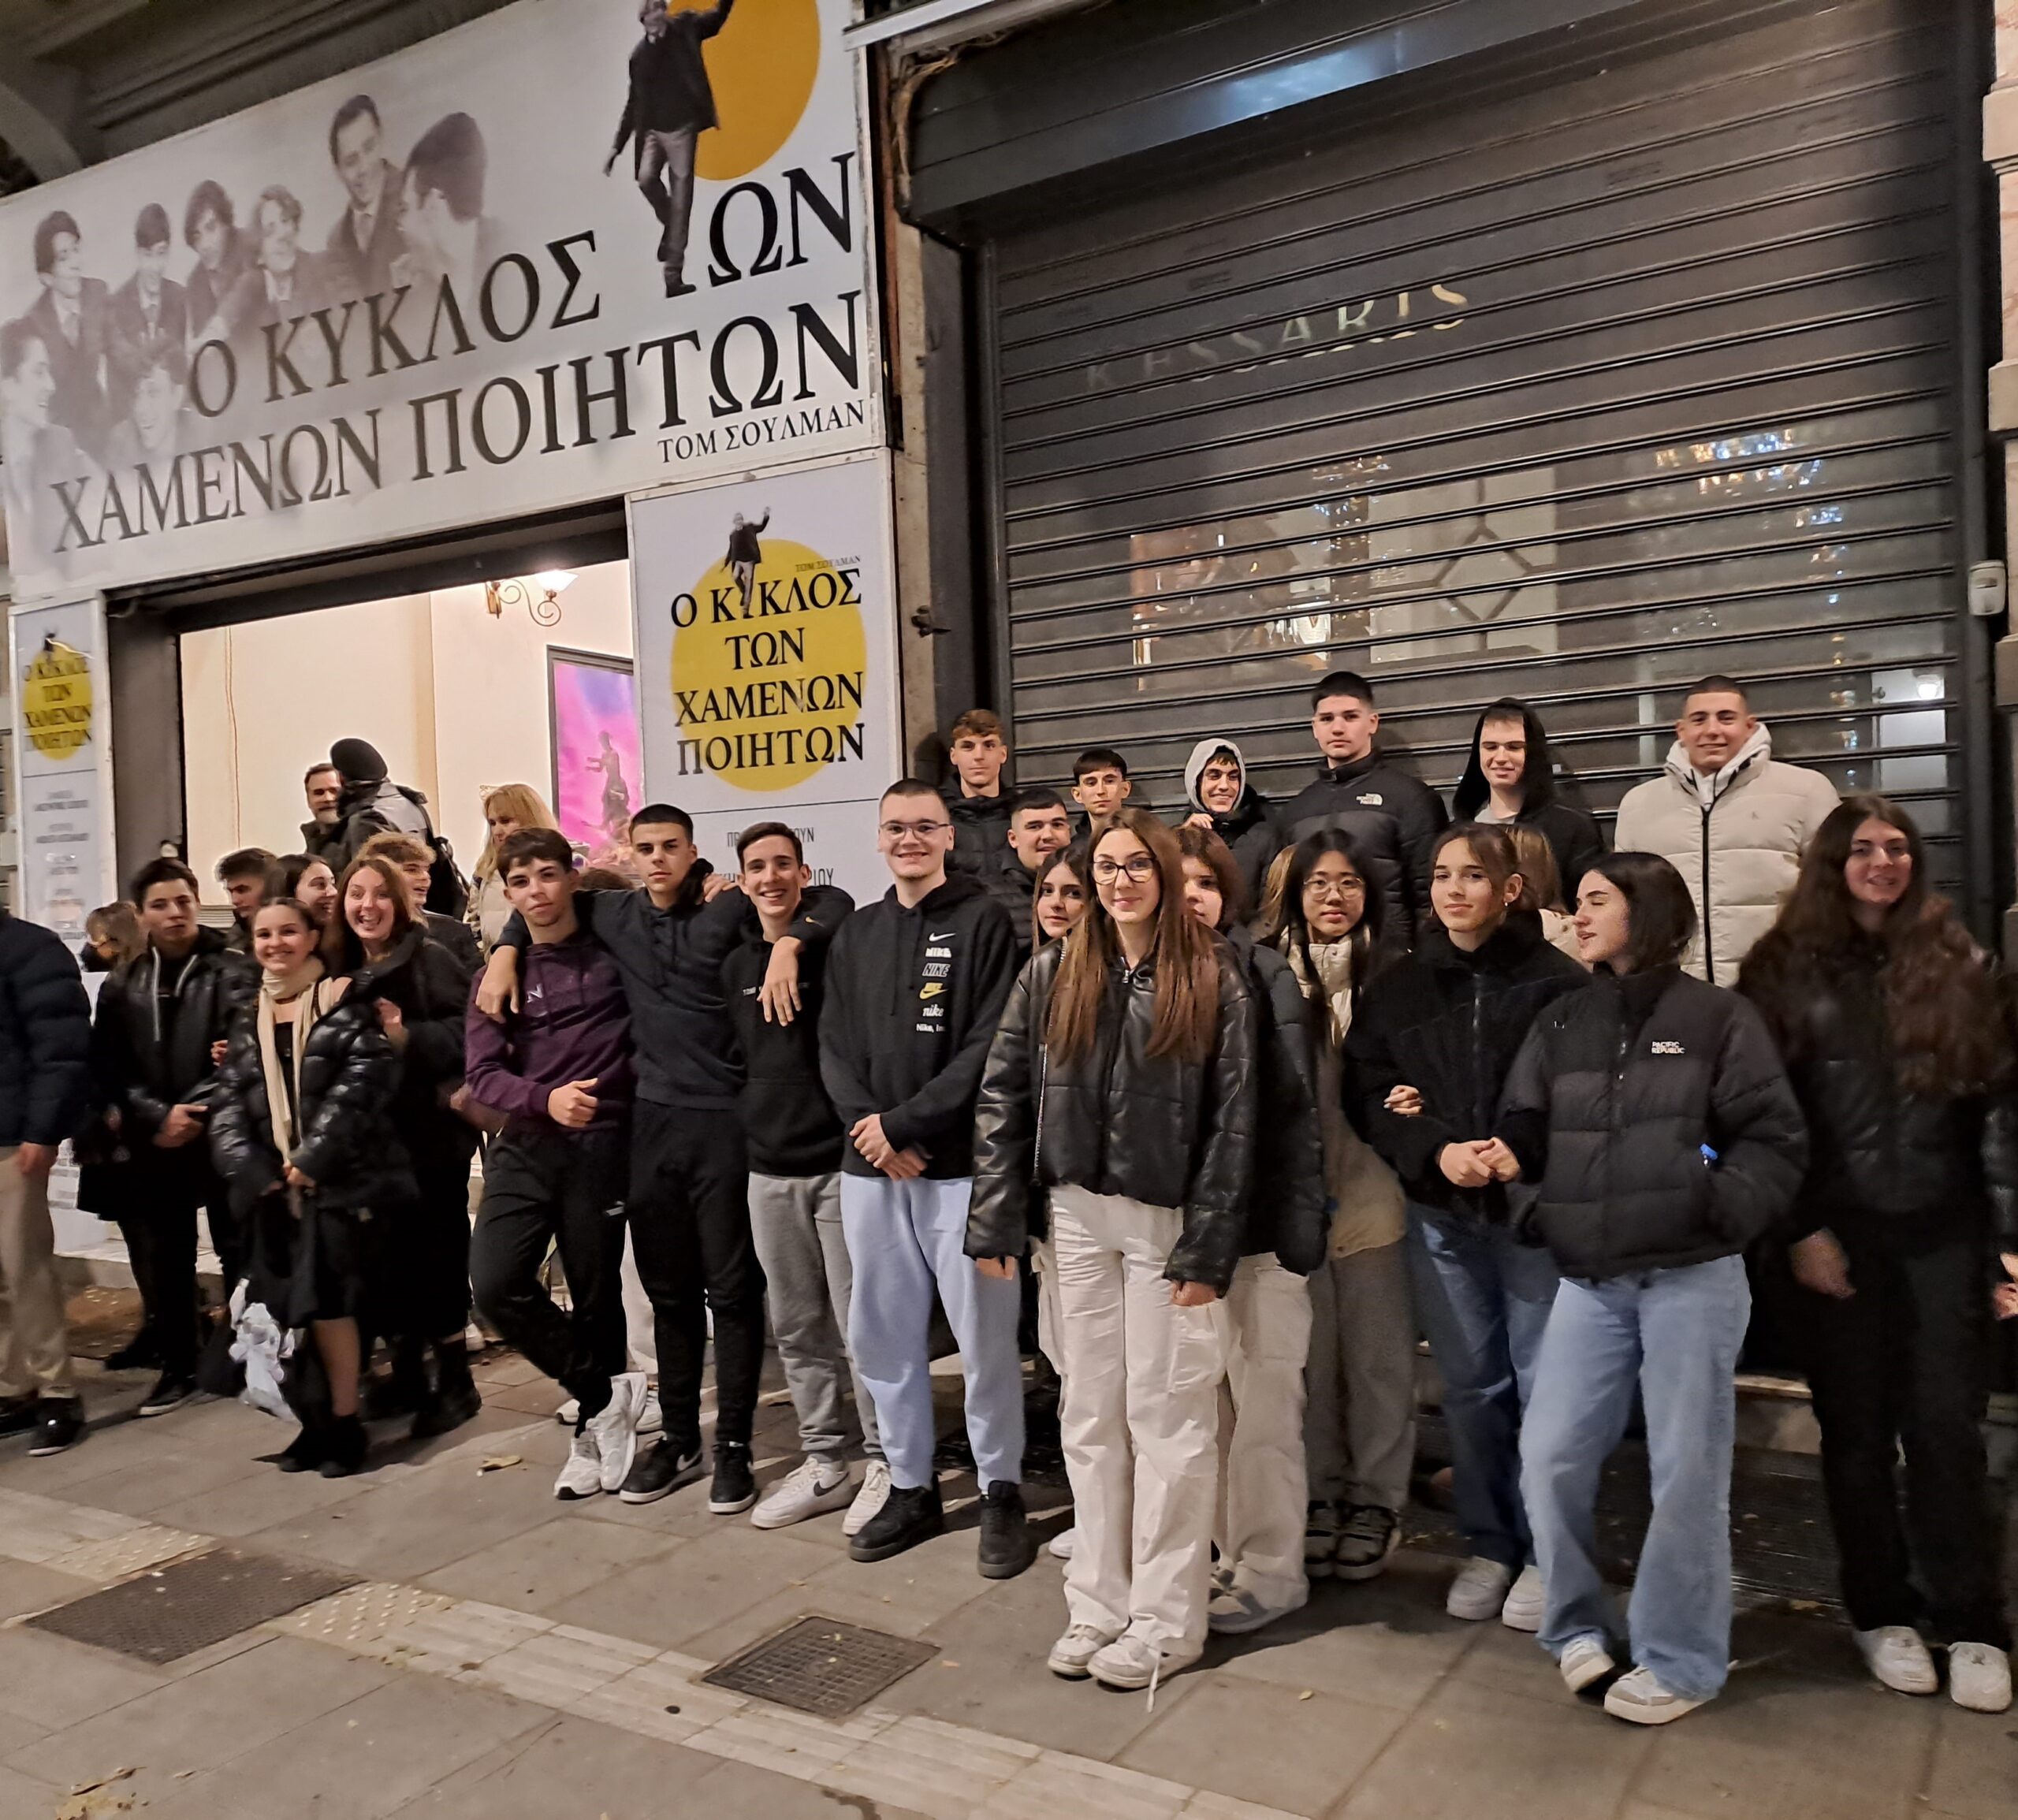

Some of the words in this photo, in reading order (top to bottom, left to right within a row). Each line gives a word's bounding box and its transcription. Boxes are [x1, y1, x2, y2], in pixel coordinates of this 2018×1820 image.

[189, 339, 237, 418] Ο
[260, 229, 601, 404] ΚΥΚΛΟΣ
[50, 408, 383, 553] ΧΑΜΕΝΩΝ
[408, 289, 862, 481] ΠΟΙΗΤΩΝ
[657, 426, 718, 463] ΤΟΜ
[724, 399, 865, 452] ΣΟΥΛΜΑΝ
[670, 592, 698, 628] Ο
[709, 568, 862, 623] ΚΚΛΟΣ
[724, 627, 805, 671] ΤΩΝ
[673, 671, 863, 728] ΧΑΜΕΝΩΝ
[676, 723, 866, 776] ΠΟΙΗΤΩΝ
[922, 962, 951, 977] NIKE
